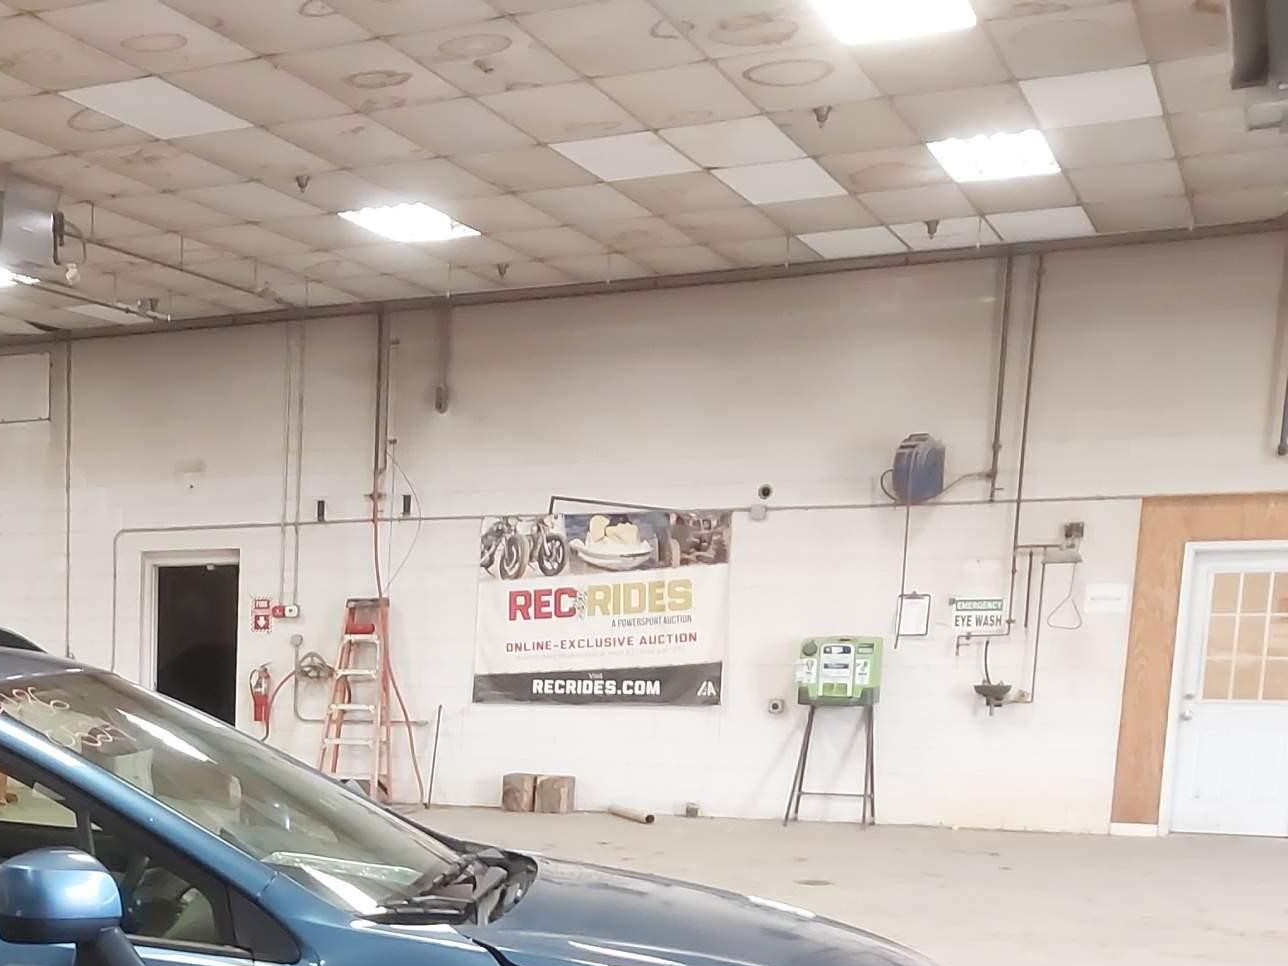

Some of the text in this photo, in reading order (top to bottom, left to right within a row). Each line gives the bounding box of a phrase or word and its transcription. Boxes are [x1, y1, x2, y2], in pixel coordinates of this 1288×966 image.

[509, 578, 693, 621] REC RIDES
[663, 615, 692, 624] AUCTION
[955, 615, 1003, 627] EYE WASH
[506, 632, 697, 653] ONLINE-EXCLUSIVE AUCTION
[531, 679, 661, 696] RECRIDES.COM
